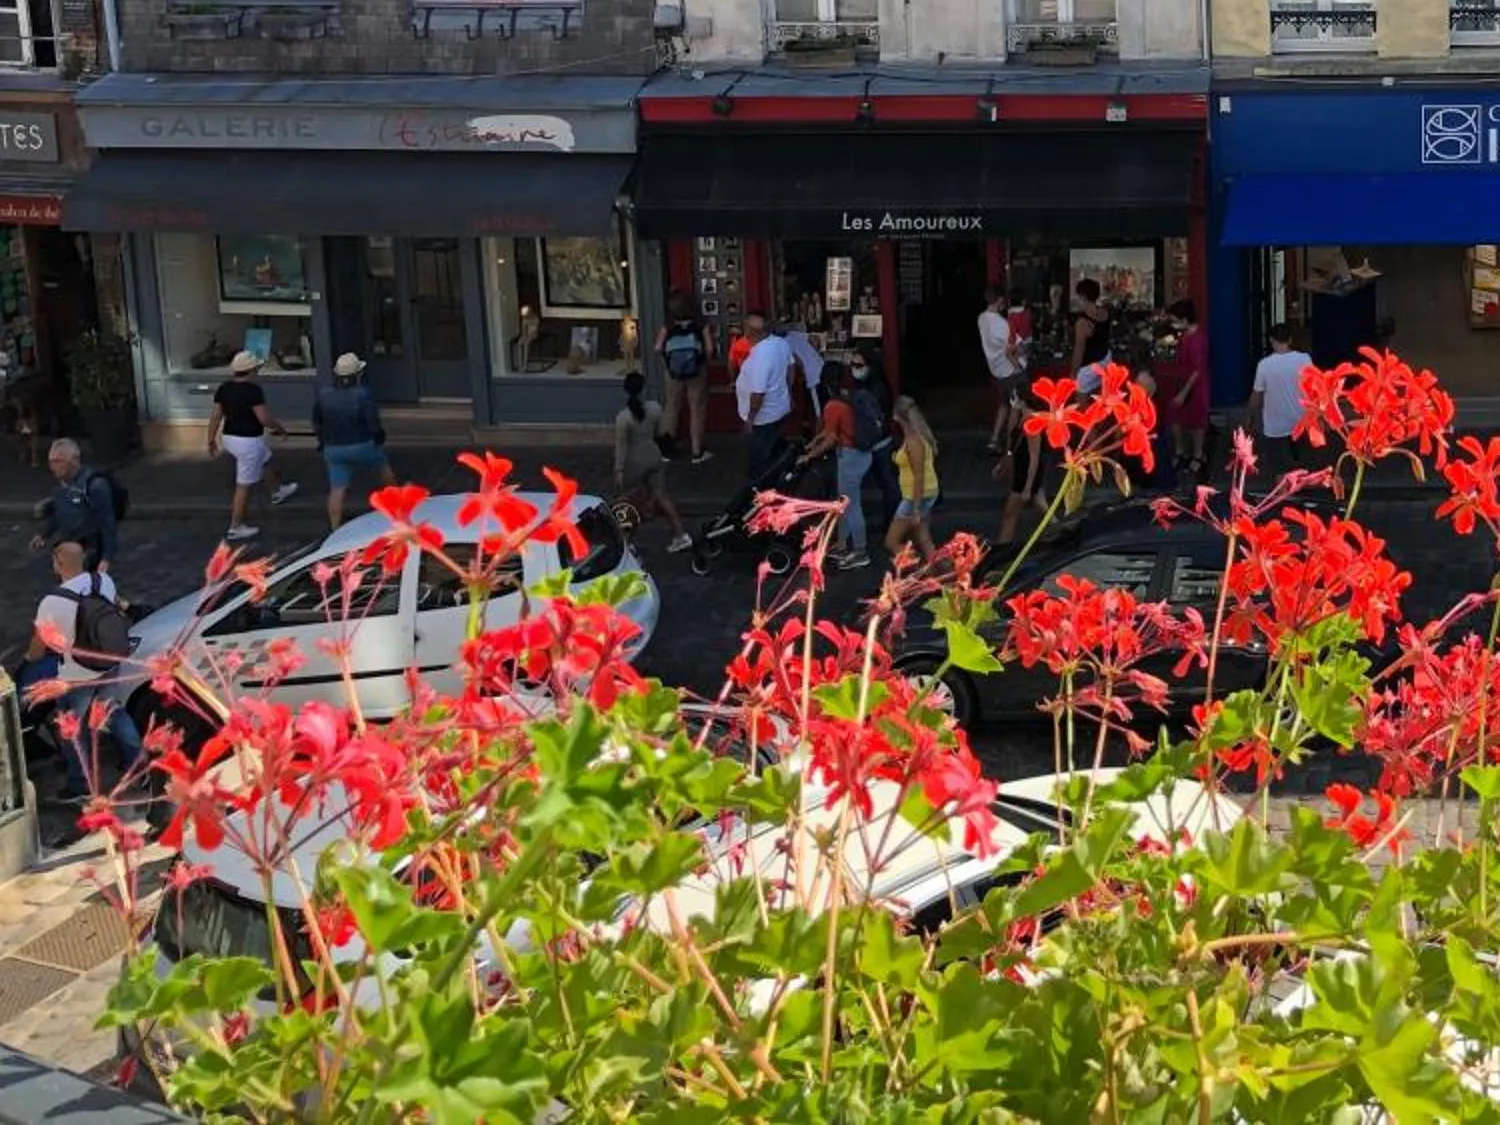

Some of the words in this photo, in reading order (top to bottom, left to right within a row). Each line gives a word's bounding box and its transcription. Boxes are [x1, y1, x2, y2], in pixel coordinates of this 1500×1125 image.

[0, 124, 43, 150] TES
[140, 115, 316, 138] GALERIE
[842, 212, 873, 230] Les
[879, 212, 983, 230] Amoureux
